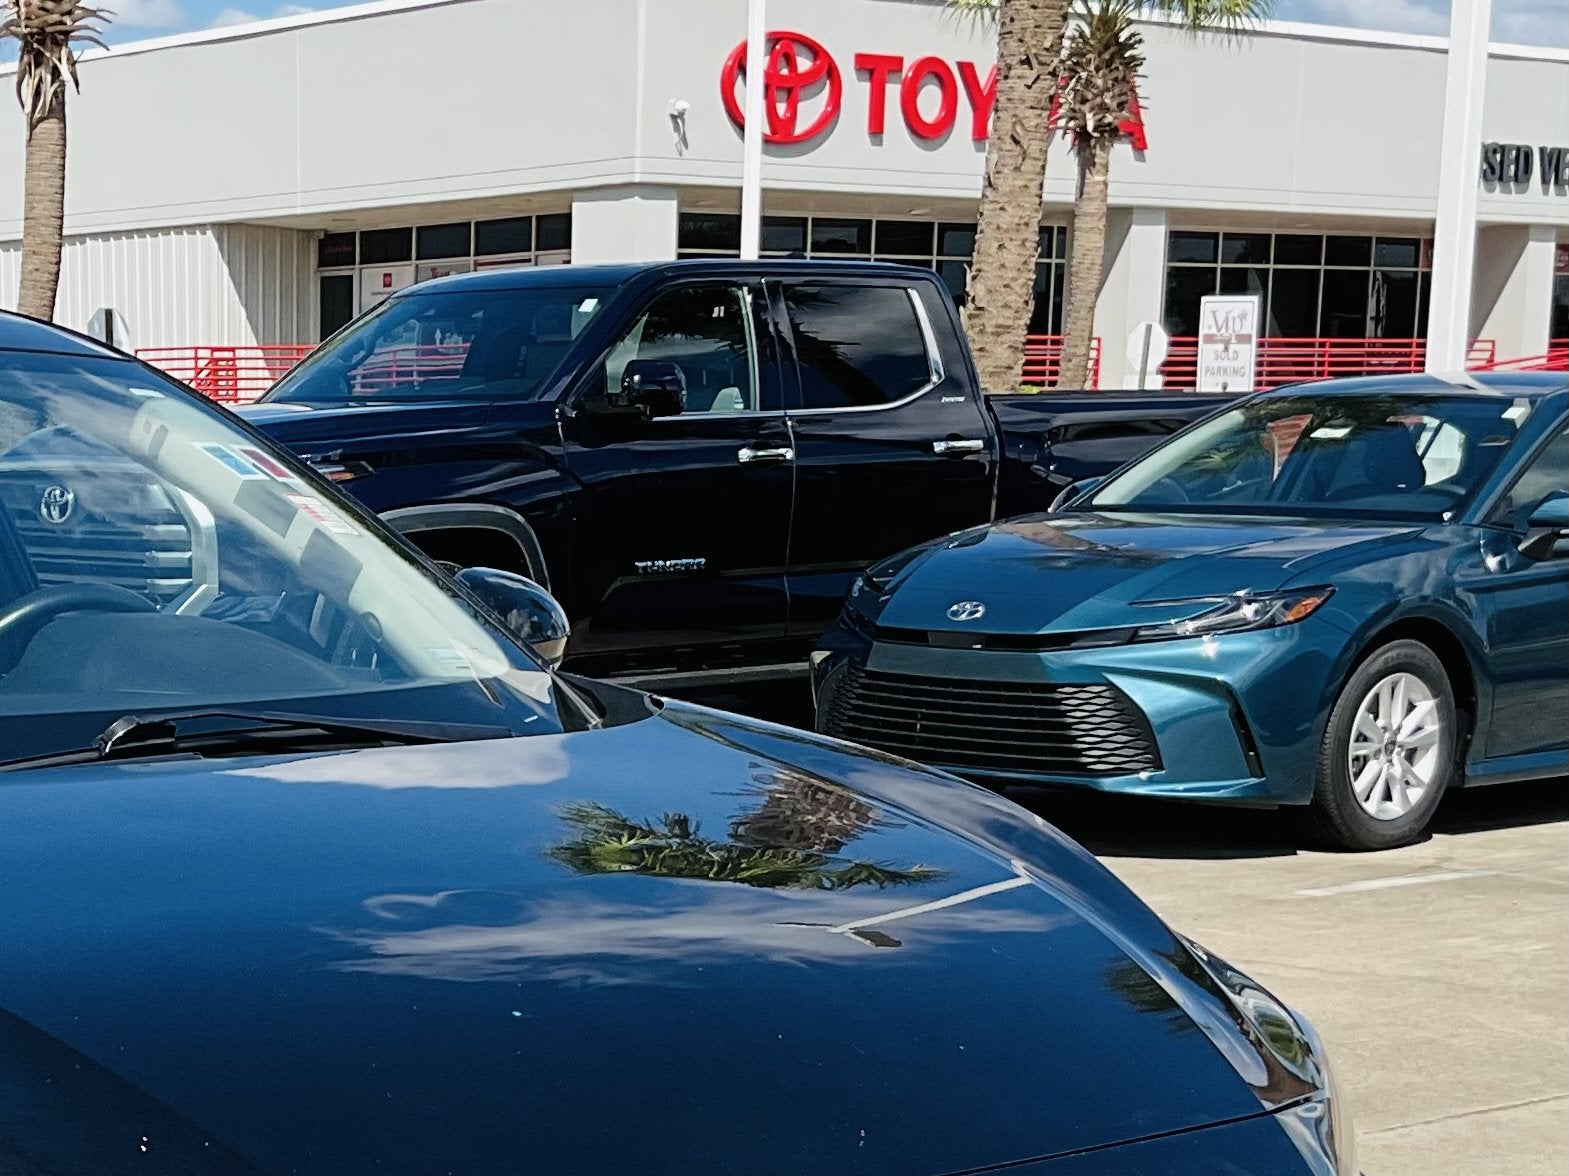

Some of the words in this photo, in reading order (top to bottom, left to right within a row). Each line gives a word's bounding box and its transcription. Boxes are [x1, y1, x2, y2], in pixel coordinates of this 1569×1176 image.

[1479, 142, 1533, 183] SED
[1213, 349, 1239, 361] SOLD
[1204, 366, 1246, 378] PARKING
